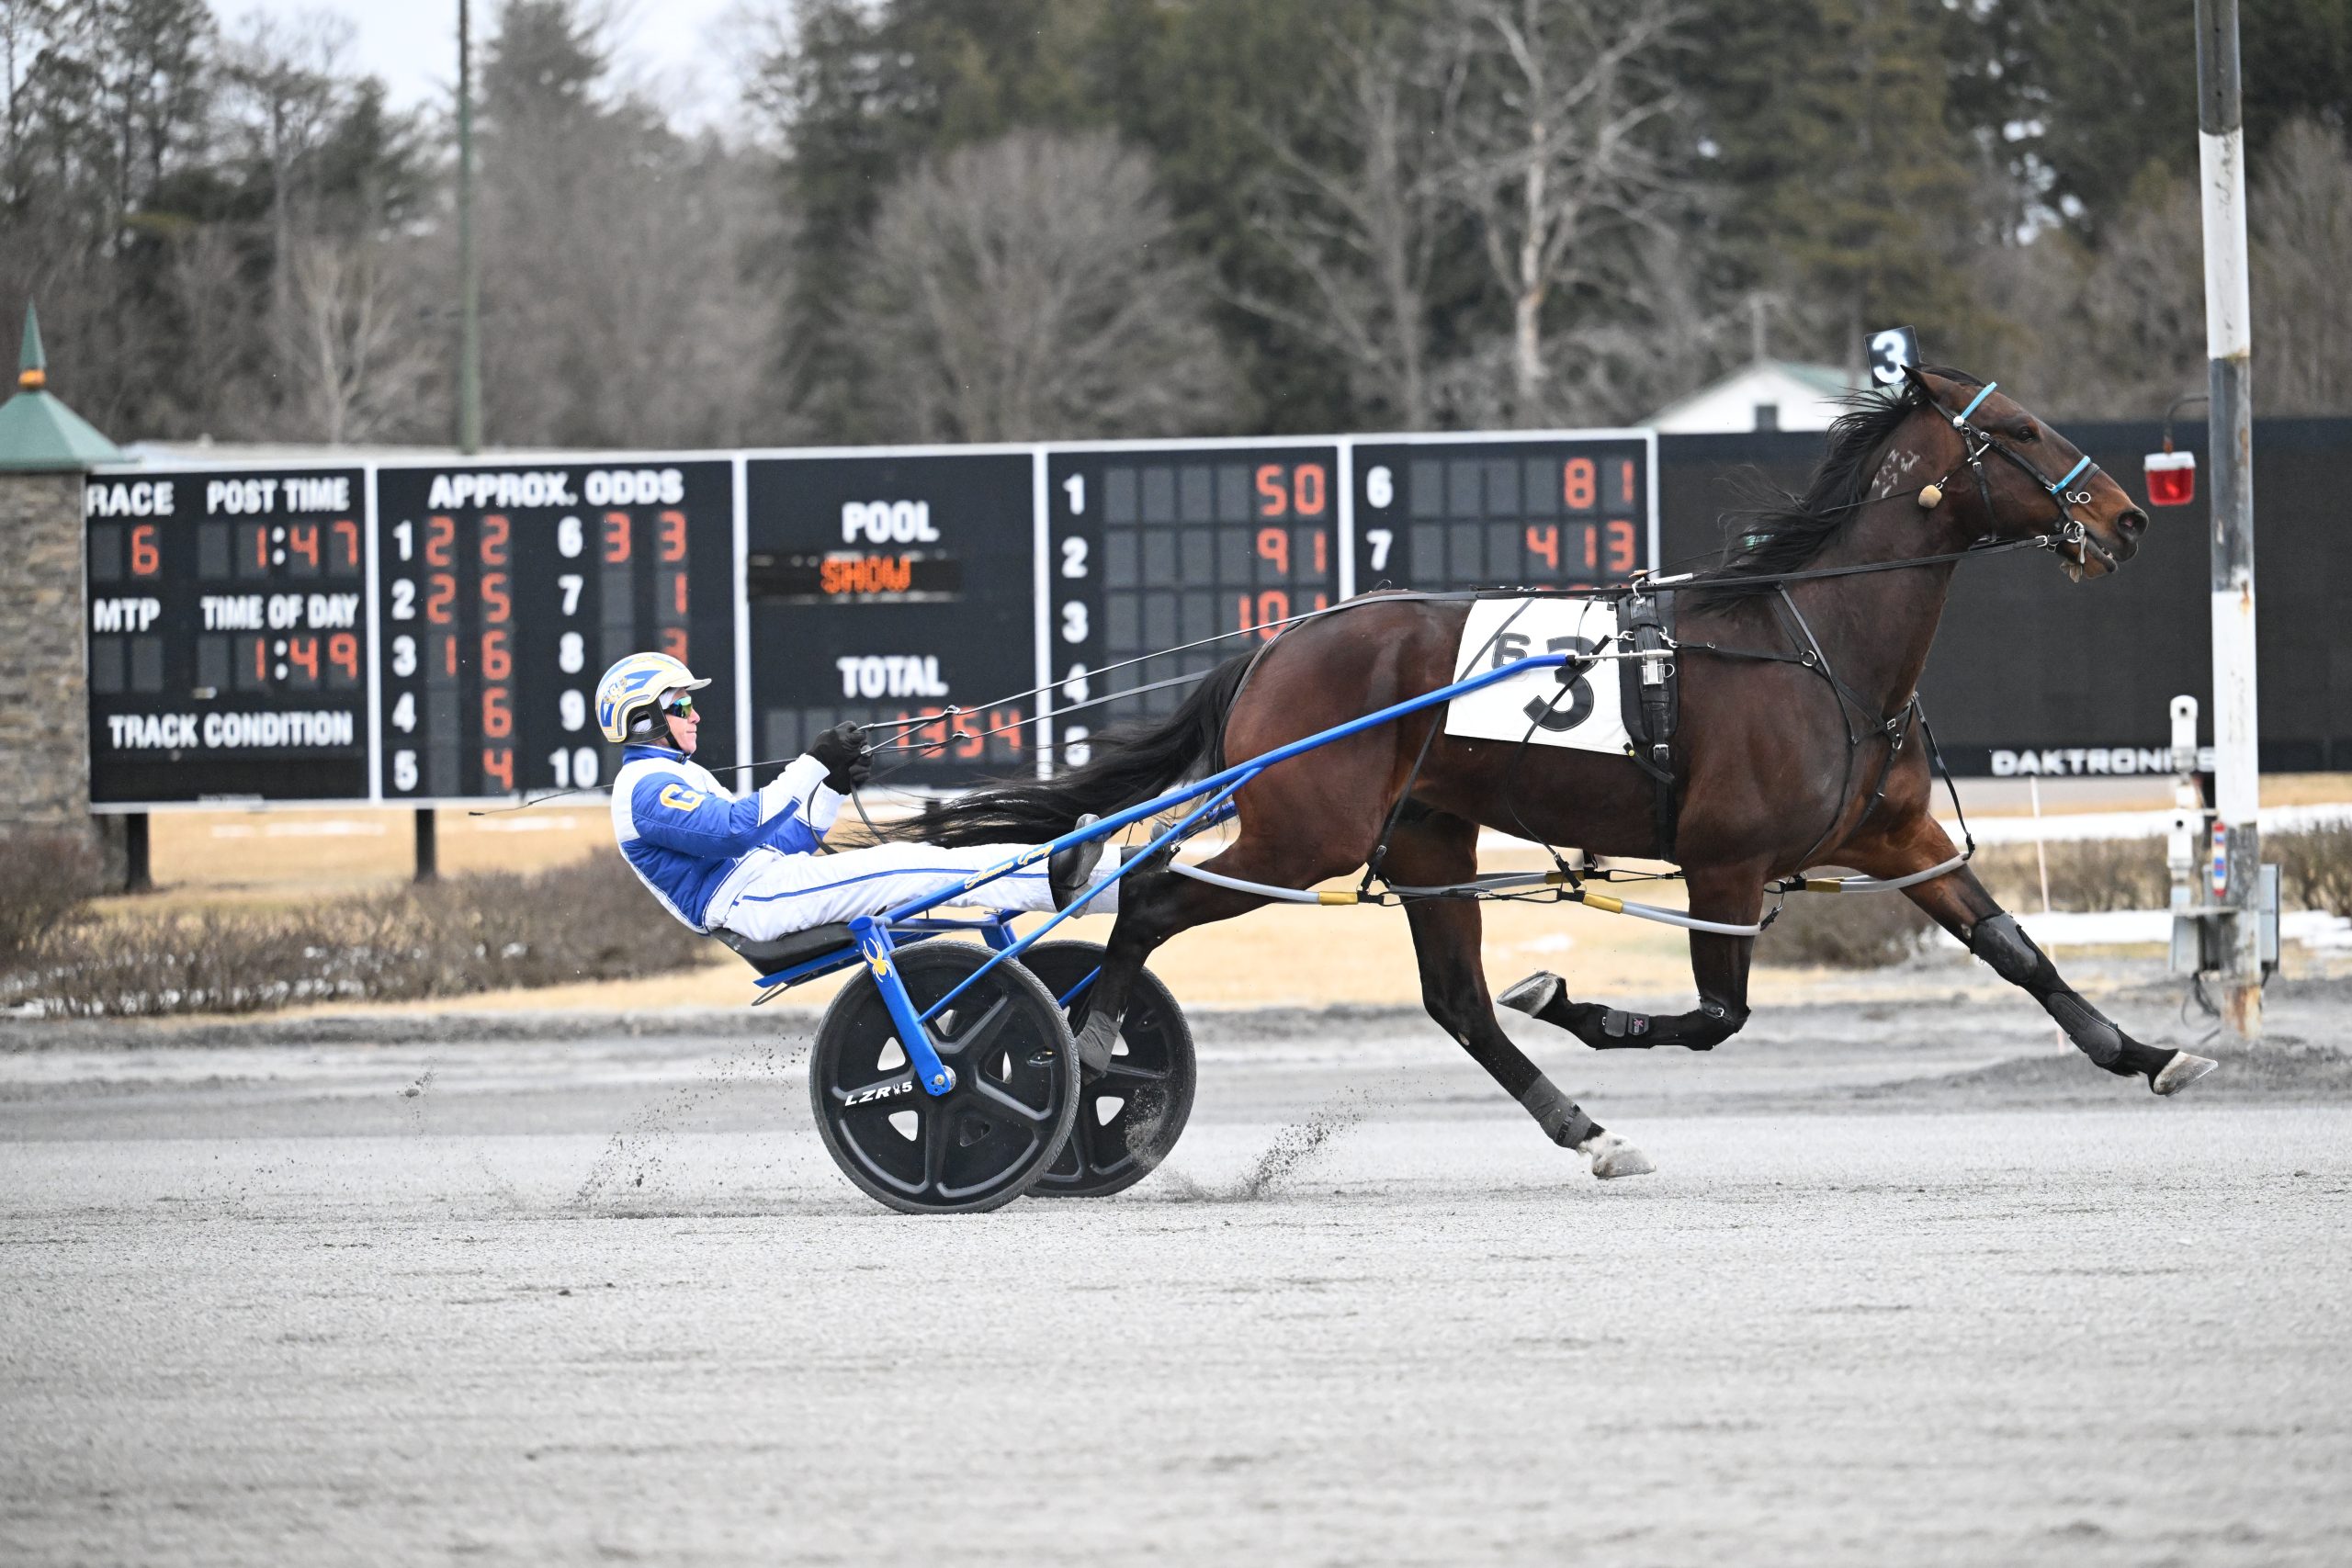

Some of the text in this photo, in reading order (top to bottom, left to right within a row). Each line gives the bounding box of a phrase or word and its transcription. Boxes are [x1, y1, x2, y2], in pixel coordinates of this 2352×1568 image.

[1871, 331, 1907, 384] 3
[85, 481, 175, 516] RACE
[207, 477, 350, 514] POST TIME
[428, 468, 684, 509] APPROX. ODDS
[1063, 464, 1325, 515] 1 50
[1366, 458, 1633, 509] 6 81
[257, 521, 357, 566] 1:47
[393, 521, 413, 561] 1
[558, 516, 583, 558] 6
[842, 501, 940, 544] POOL
[131, 525, 159, 574] 6
[1062, 536, 1088, 579] 2
[1366, 521, 1634, 571] 7 413
[558, 574, 687, 615] 7 1
[820, 556, 912, 594] SHOW
[94, 598, 161, 632] MTP
[200, 593, 359, 630] TIME OF DAY
[391, 579, 415, 620] 2
[1062, 601, 1089, 643] 3
[256, 633, 357, 680] 1:49
[392, 635, 417, 677] 3
[559, 632, 584, 674] 8
[836, 655, 949, 698] TOTAL
[1063, 663, 1090, 704] 4
[1522, 635, 1600, 733] 3
[108, 711, 353, 749] TRACK CONDITION
[392, 687, 512, 738] 4 6
[560, 689, 585, 731] 9
[549, 747, 598, 789] 10
[1064, 726, 1091, 768] 5
[1991, 748, 2215, 775] DAKTRONIS
[394, 750, 513, 791] 5 4
[844, 1086, 891, 1107] LZR
